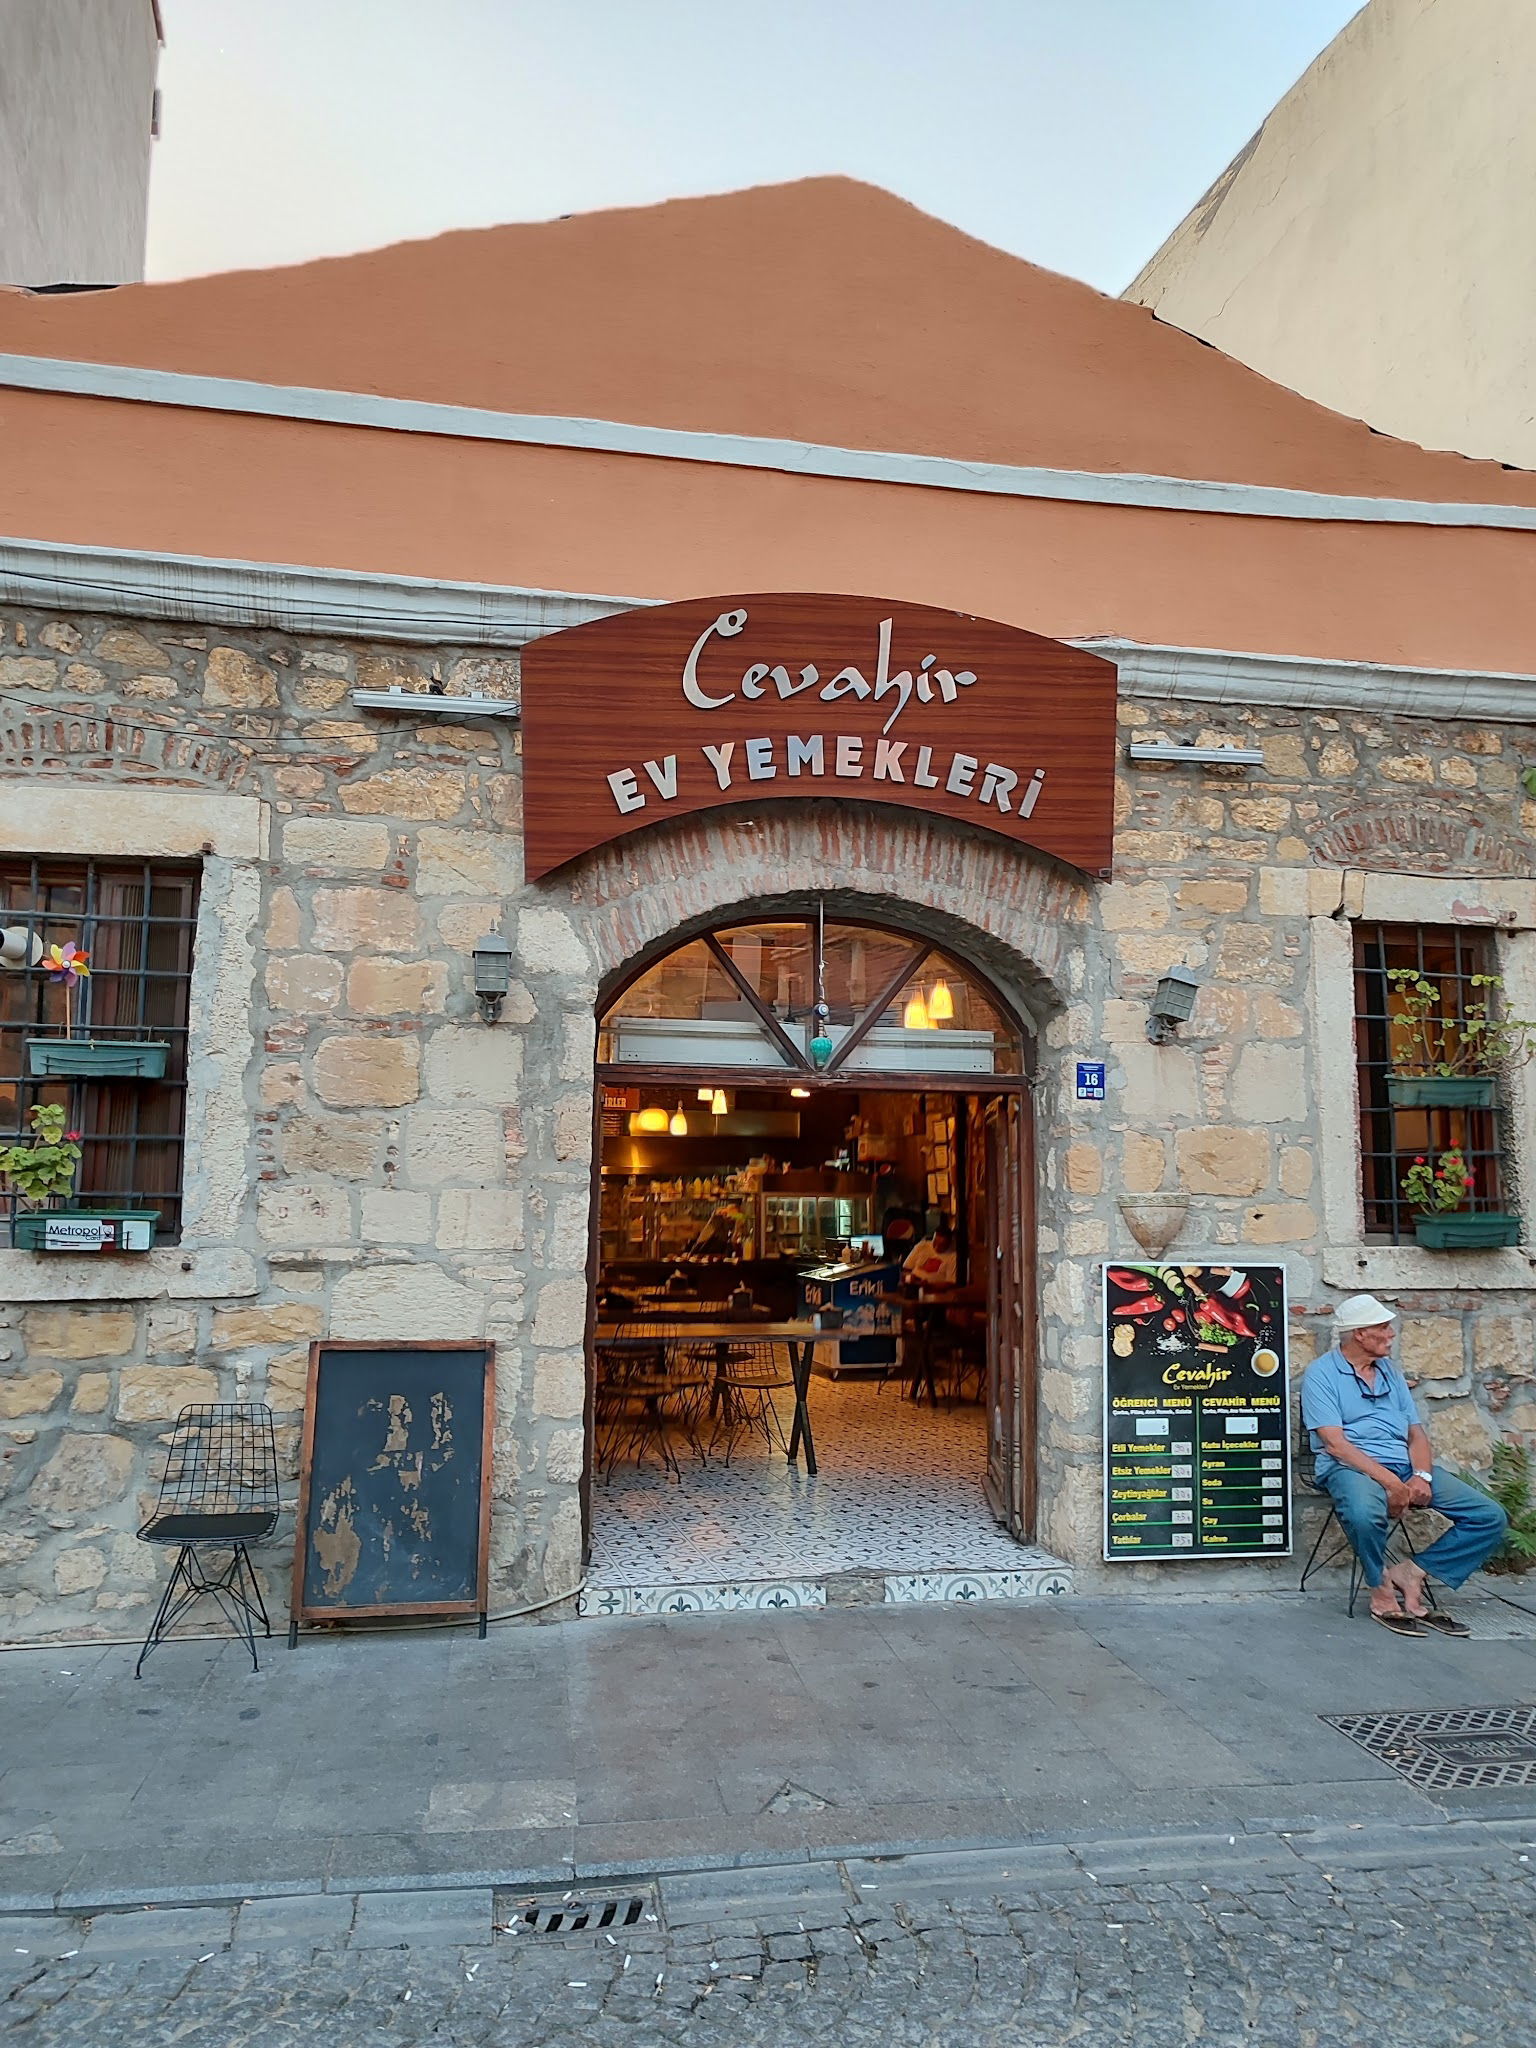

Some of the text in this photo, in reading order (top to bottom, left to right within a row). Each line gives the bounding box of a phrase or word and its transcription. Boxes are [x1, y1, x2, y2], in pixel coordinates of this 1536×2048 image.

[681, 608, 978, 735] Cevahir
[606, 735, 1046, 819] EV YEMEKLERİ
[1084, 1073, 1098, 1086] 16
[49, 1225, 101, 1237] Metropol
[1162, 1362, 1233, 1388] Cevahir
[1112, 1396, 1193, 1408] ÖĞRENCİ MENÜ
[1202, 1394, 1281, 1407] CEVAHİR MENÜ
[1202, 1461, 1226, 1469] Ayran
[1202, 1479, 1223, 1487] Soda
